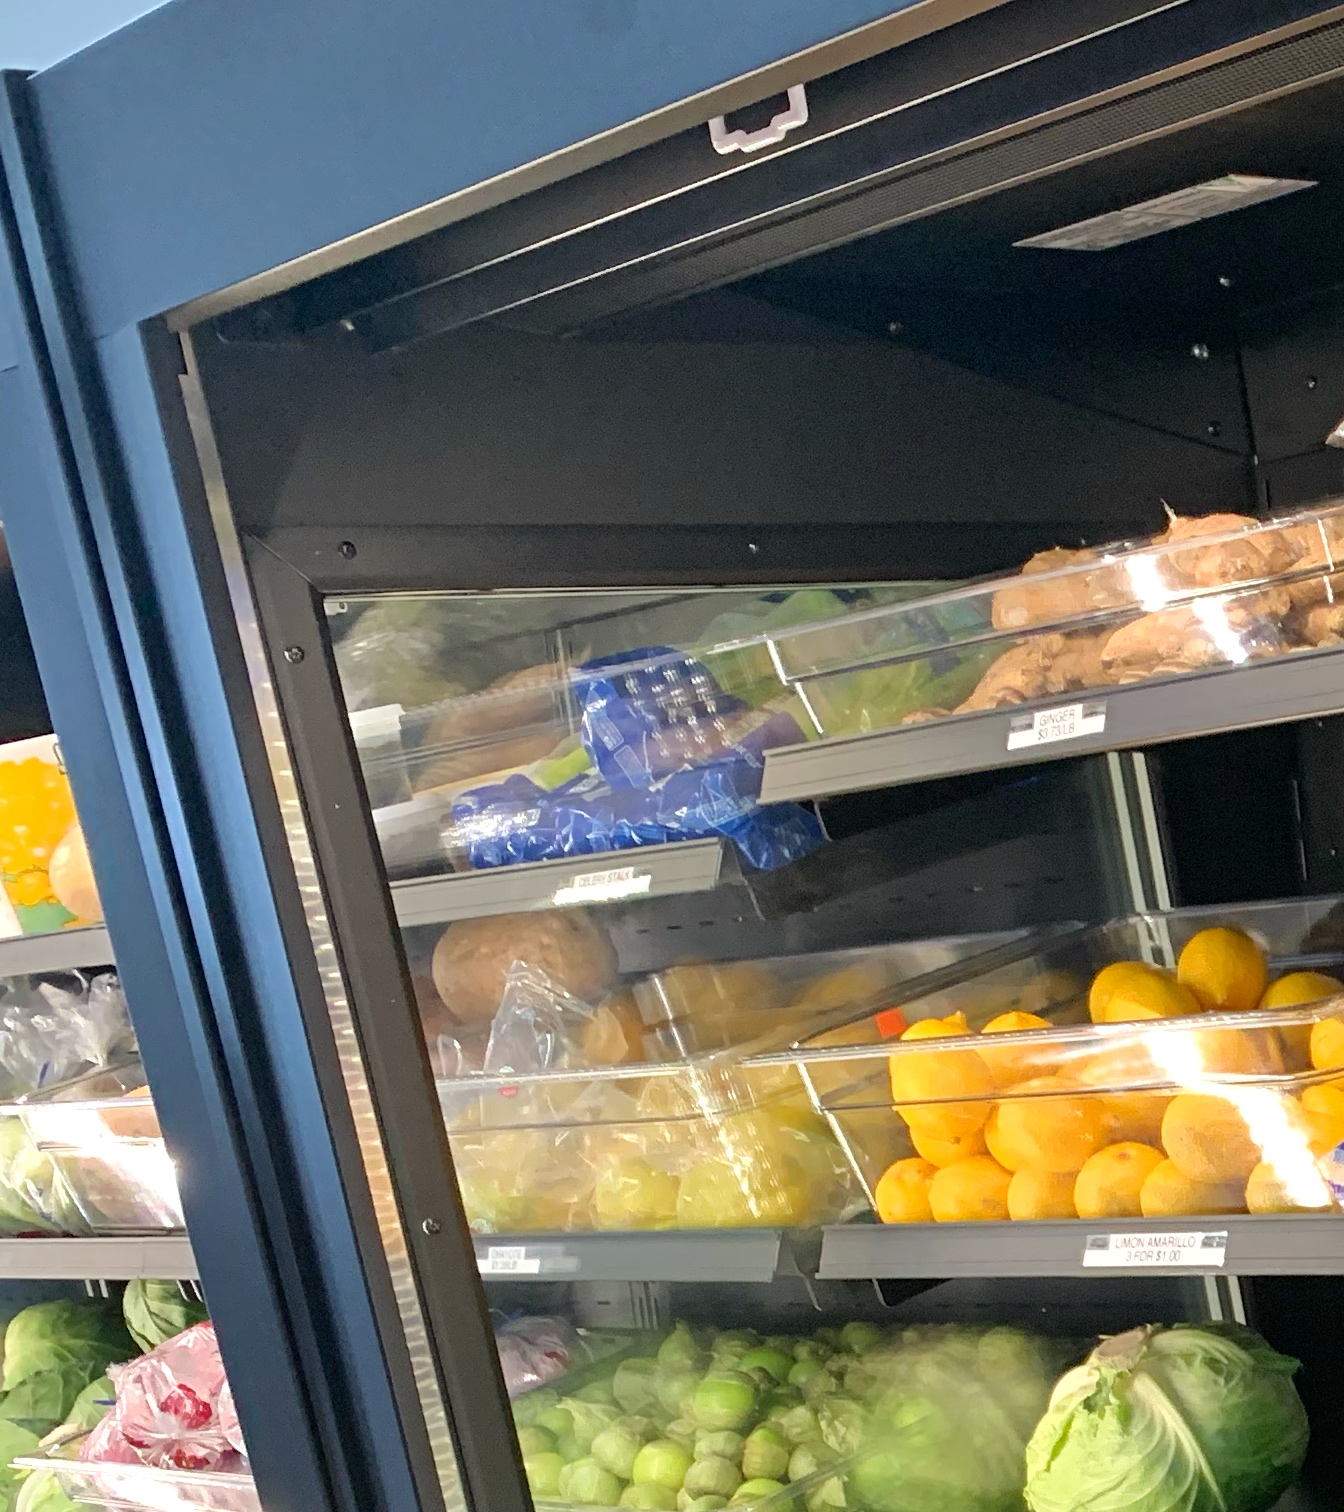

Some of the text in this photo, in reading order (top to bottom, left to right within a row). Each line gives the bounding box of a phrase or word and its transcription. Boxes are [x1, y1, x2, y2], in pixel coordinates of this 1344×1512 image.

[1039, 709, 1075, 726] GINGER
[607, 870, 629, 883] STALK
[1147, 1235, 1196, 1248] AMARILLO
[1125, 1250, 1181, 1262] 3 FOR $1.00
